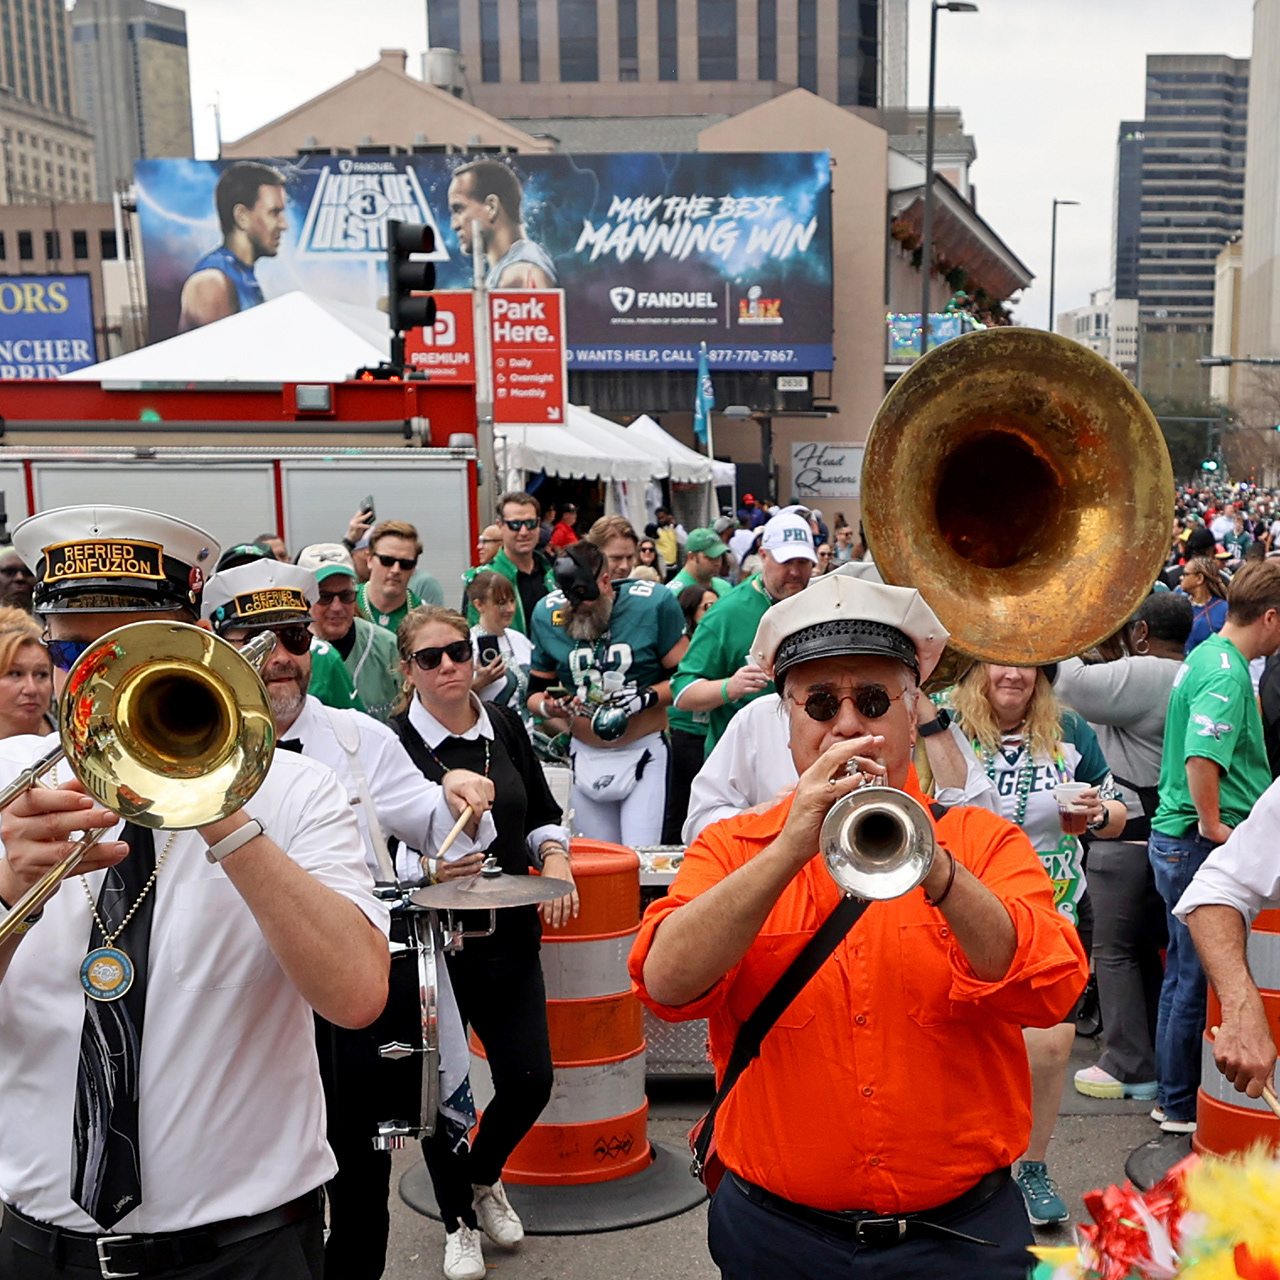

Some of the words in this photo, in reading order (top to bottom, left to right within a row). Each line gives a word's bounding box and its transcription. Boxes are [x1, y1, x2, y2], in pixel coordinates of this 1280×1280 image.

[354, 161, 397, 172] FANDUEL
[361, 195, 377, 215] 3
[607, 194, 664, 223] MAY
[663, 193, 715, 222] THE
[711, 194, 786, 222] BEST
[575, 216, 741, 264] MANNING
[745, 216, 818, 261] WIN
[492, 297, 545, 320] Park
[637, 292, 718, 309] FANDUEL
[493, 321, 555, 343] Here.
[411, 352, 471, 366] PREMIUM
[508, 357, 533, 370] Daily
[577, 350, 622, 363] WANTS
[625, 350, 660, 364] HELP,
[662, 349, 695, 363] CALL
[699, 349, 798, 363] -877-770-7867.
[509, 373, 555, 385] Overnight
[510, 387, 547, 399] Monthly
[793, 442, 846, 469] Head
[795, 466, 857, 493] Quarters
[783, 528, 810, 543] PHI
[64, 544, 135, 562] REFRIED
[54, 558, 151, 576] CONFUZION
[245, 598, 301, 612] CONFUZION
[252, 590, 293, 603] REFRIED
[1219, 652, 1232, 669] 1
